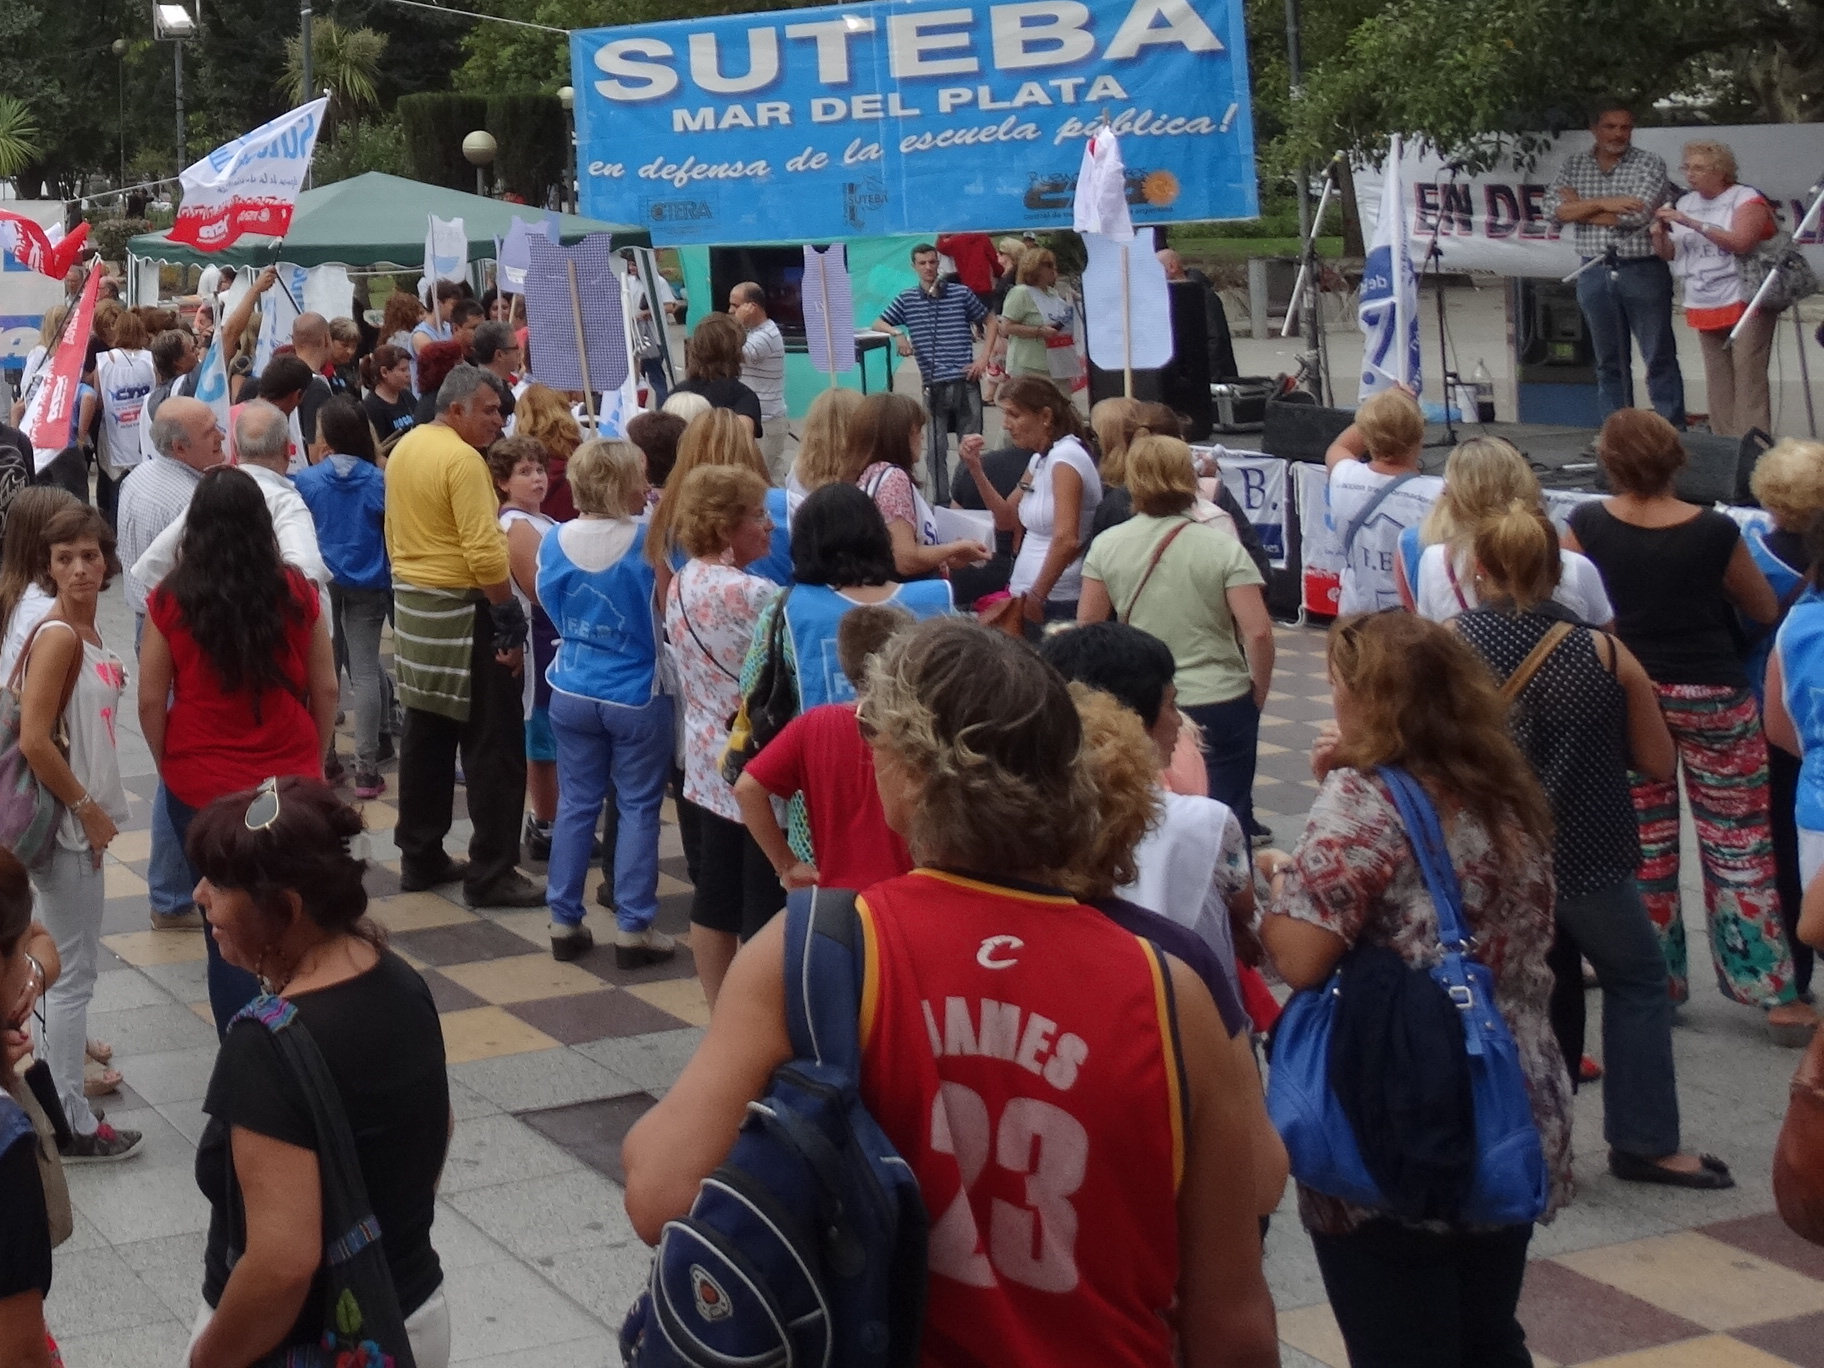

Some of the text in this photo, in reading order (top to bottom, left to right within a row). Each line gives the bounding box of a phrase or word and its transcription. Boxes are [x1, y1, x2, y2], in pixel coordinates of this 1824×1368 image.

[672, 75, 1129, 132] MAR DEL PLATA
[588, 158, 625, 177] en
[637, 155, 771, 189] defensa
[785, 145, 829, 173] de
[843, 137, 883, 164] la
[899, 114, 1043, 154] escuela
[1413, 182, 1474, 236] EN
[927, 1080, 1089, 1294] 23
